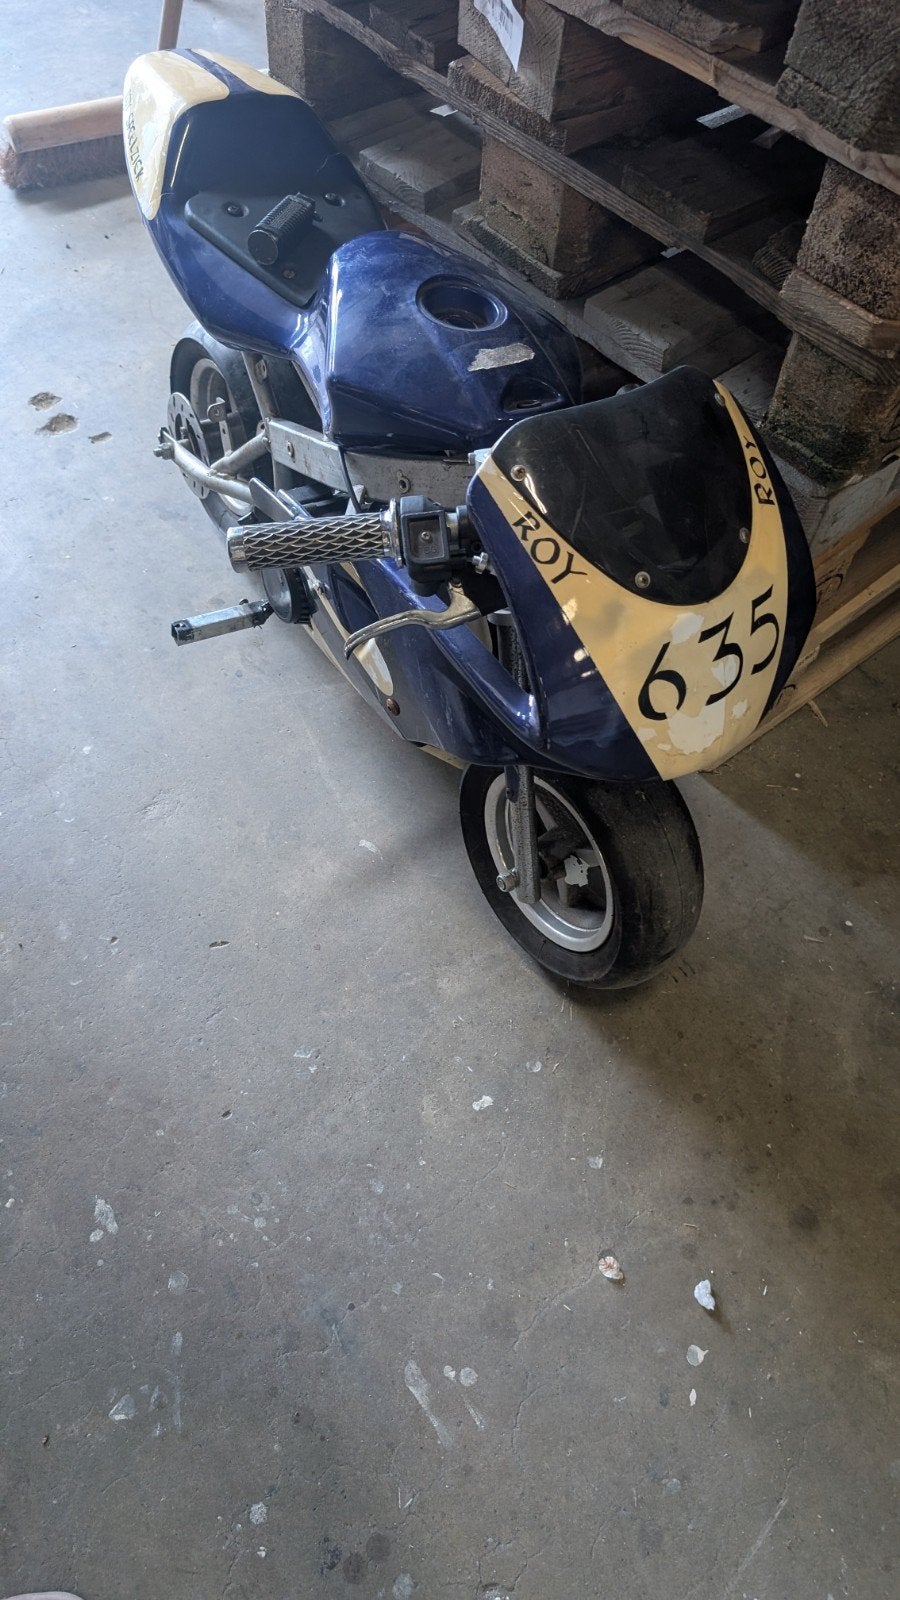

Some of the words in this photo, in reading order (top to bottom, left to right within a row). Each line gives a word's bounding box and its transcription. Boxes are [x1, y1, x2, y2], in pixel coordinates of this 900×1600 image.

[743, 435, 775, 505] ROY
[512, 511, 588, 584] ROY
[638, 583, 780, 721] 635
